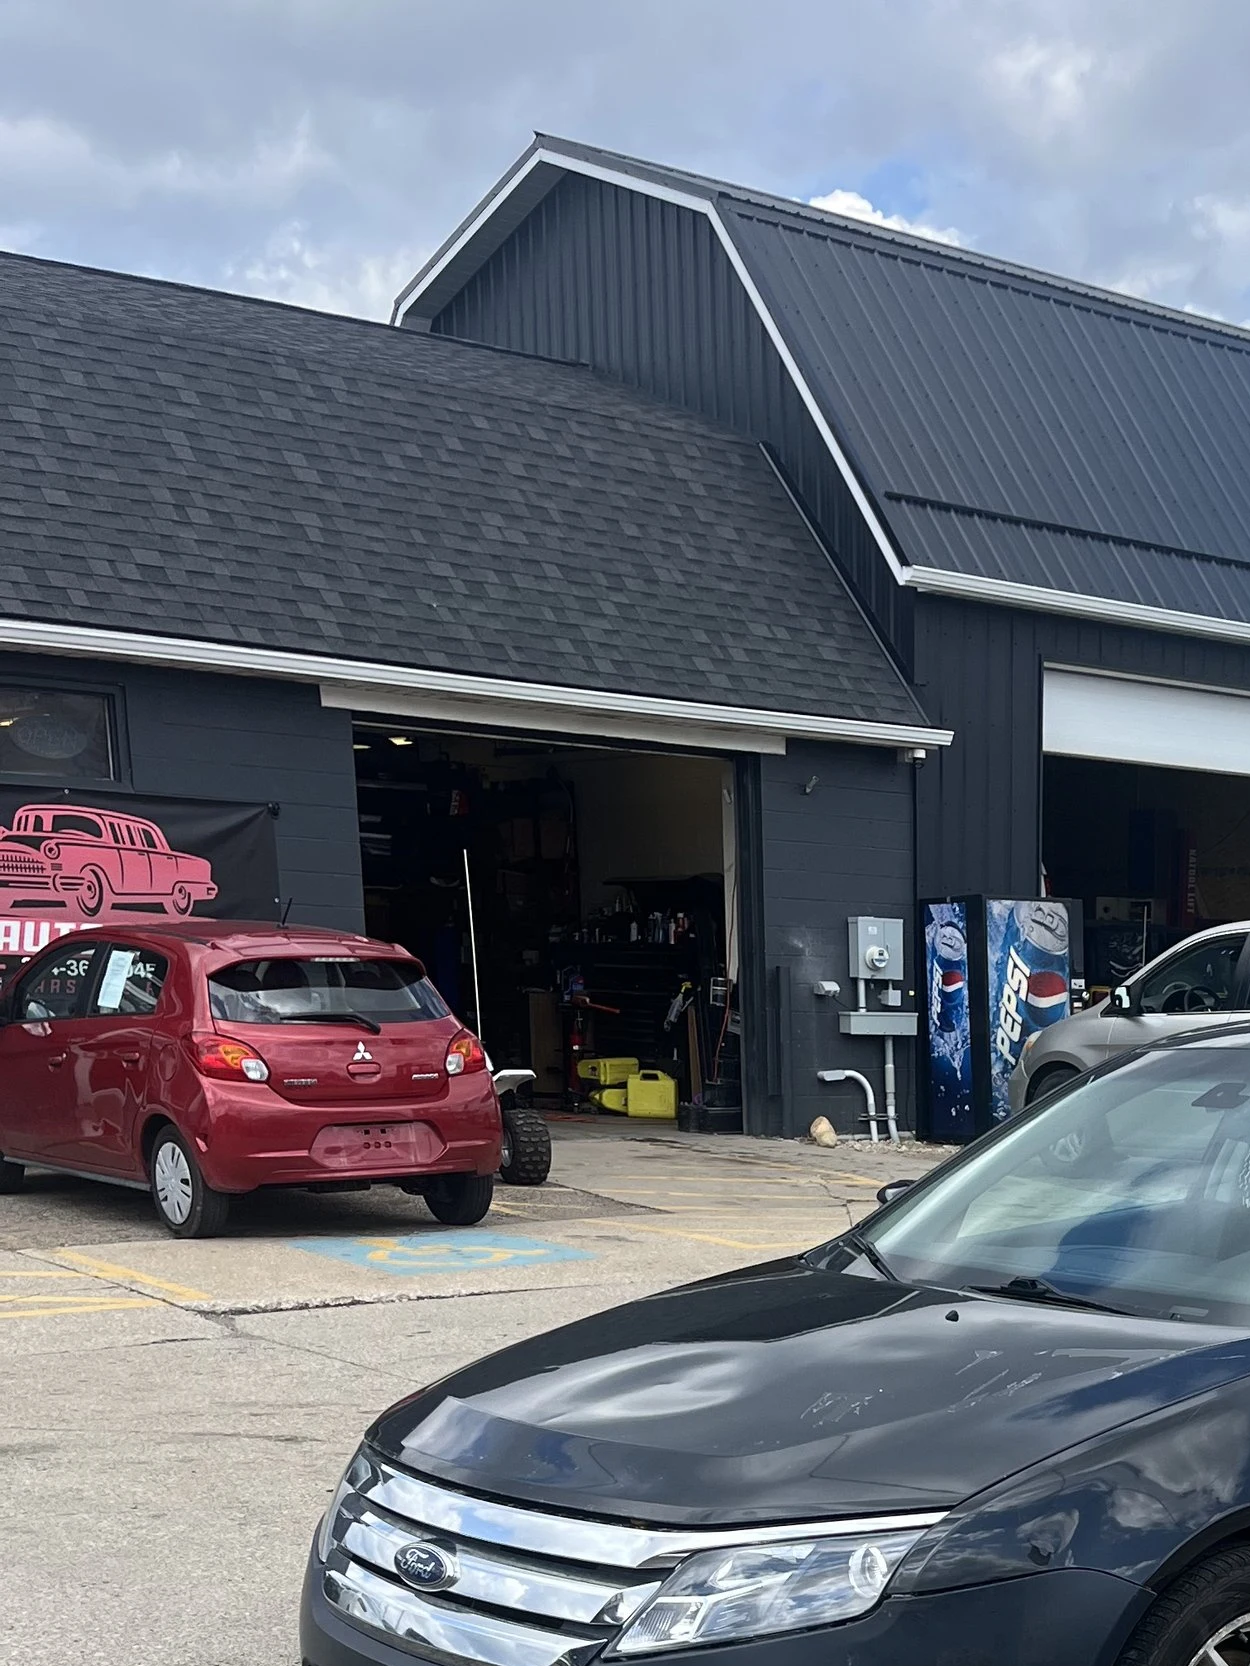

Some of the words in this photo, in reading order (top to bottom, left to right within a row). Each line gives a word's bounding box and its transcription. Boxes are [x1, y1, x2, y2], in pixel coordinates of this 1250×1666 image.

[0, 920, 103, 953] AUT
[931, 959, 943, 1028] PEPSI
[996, 945, 1031, 1066] PEPSI
[397, 1548, 435, 1578] Ford
